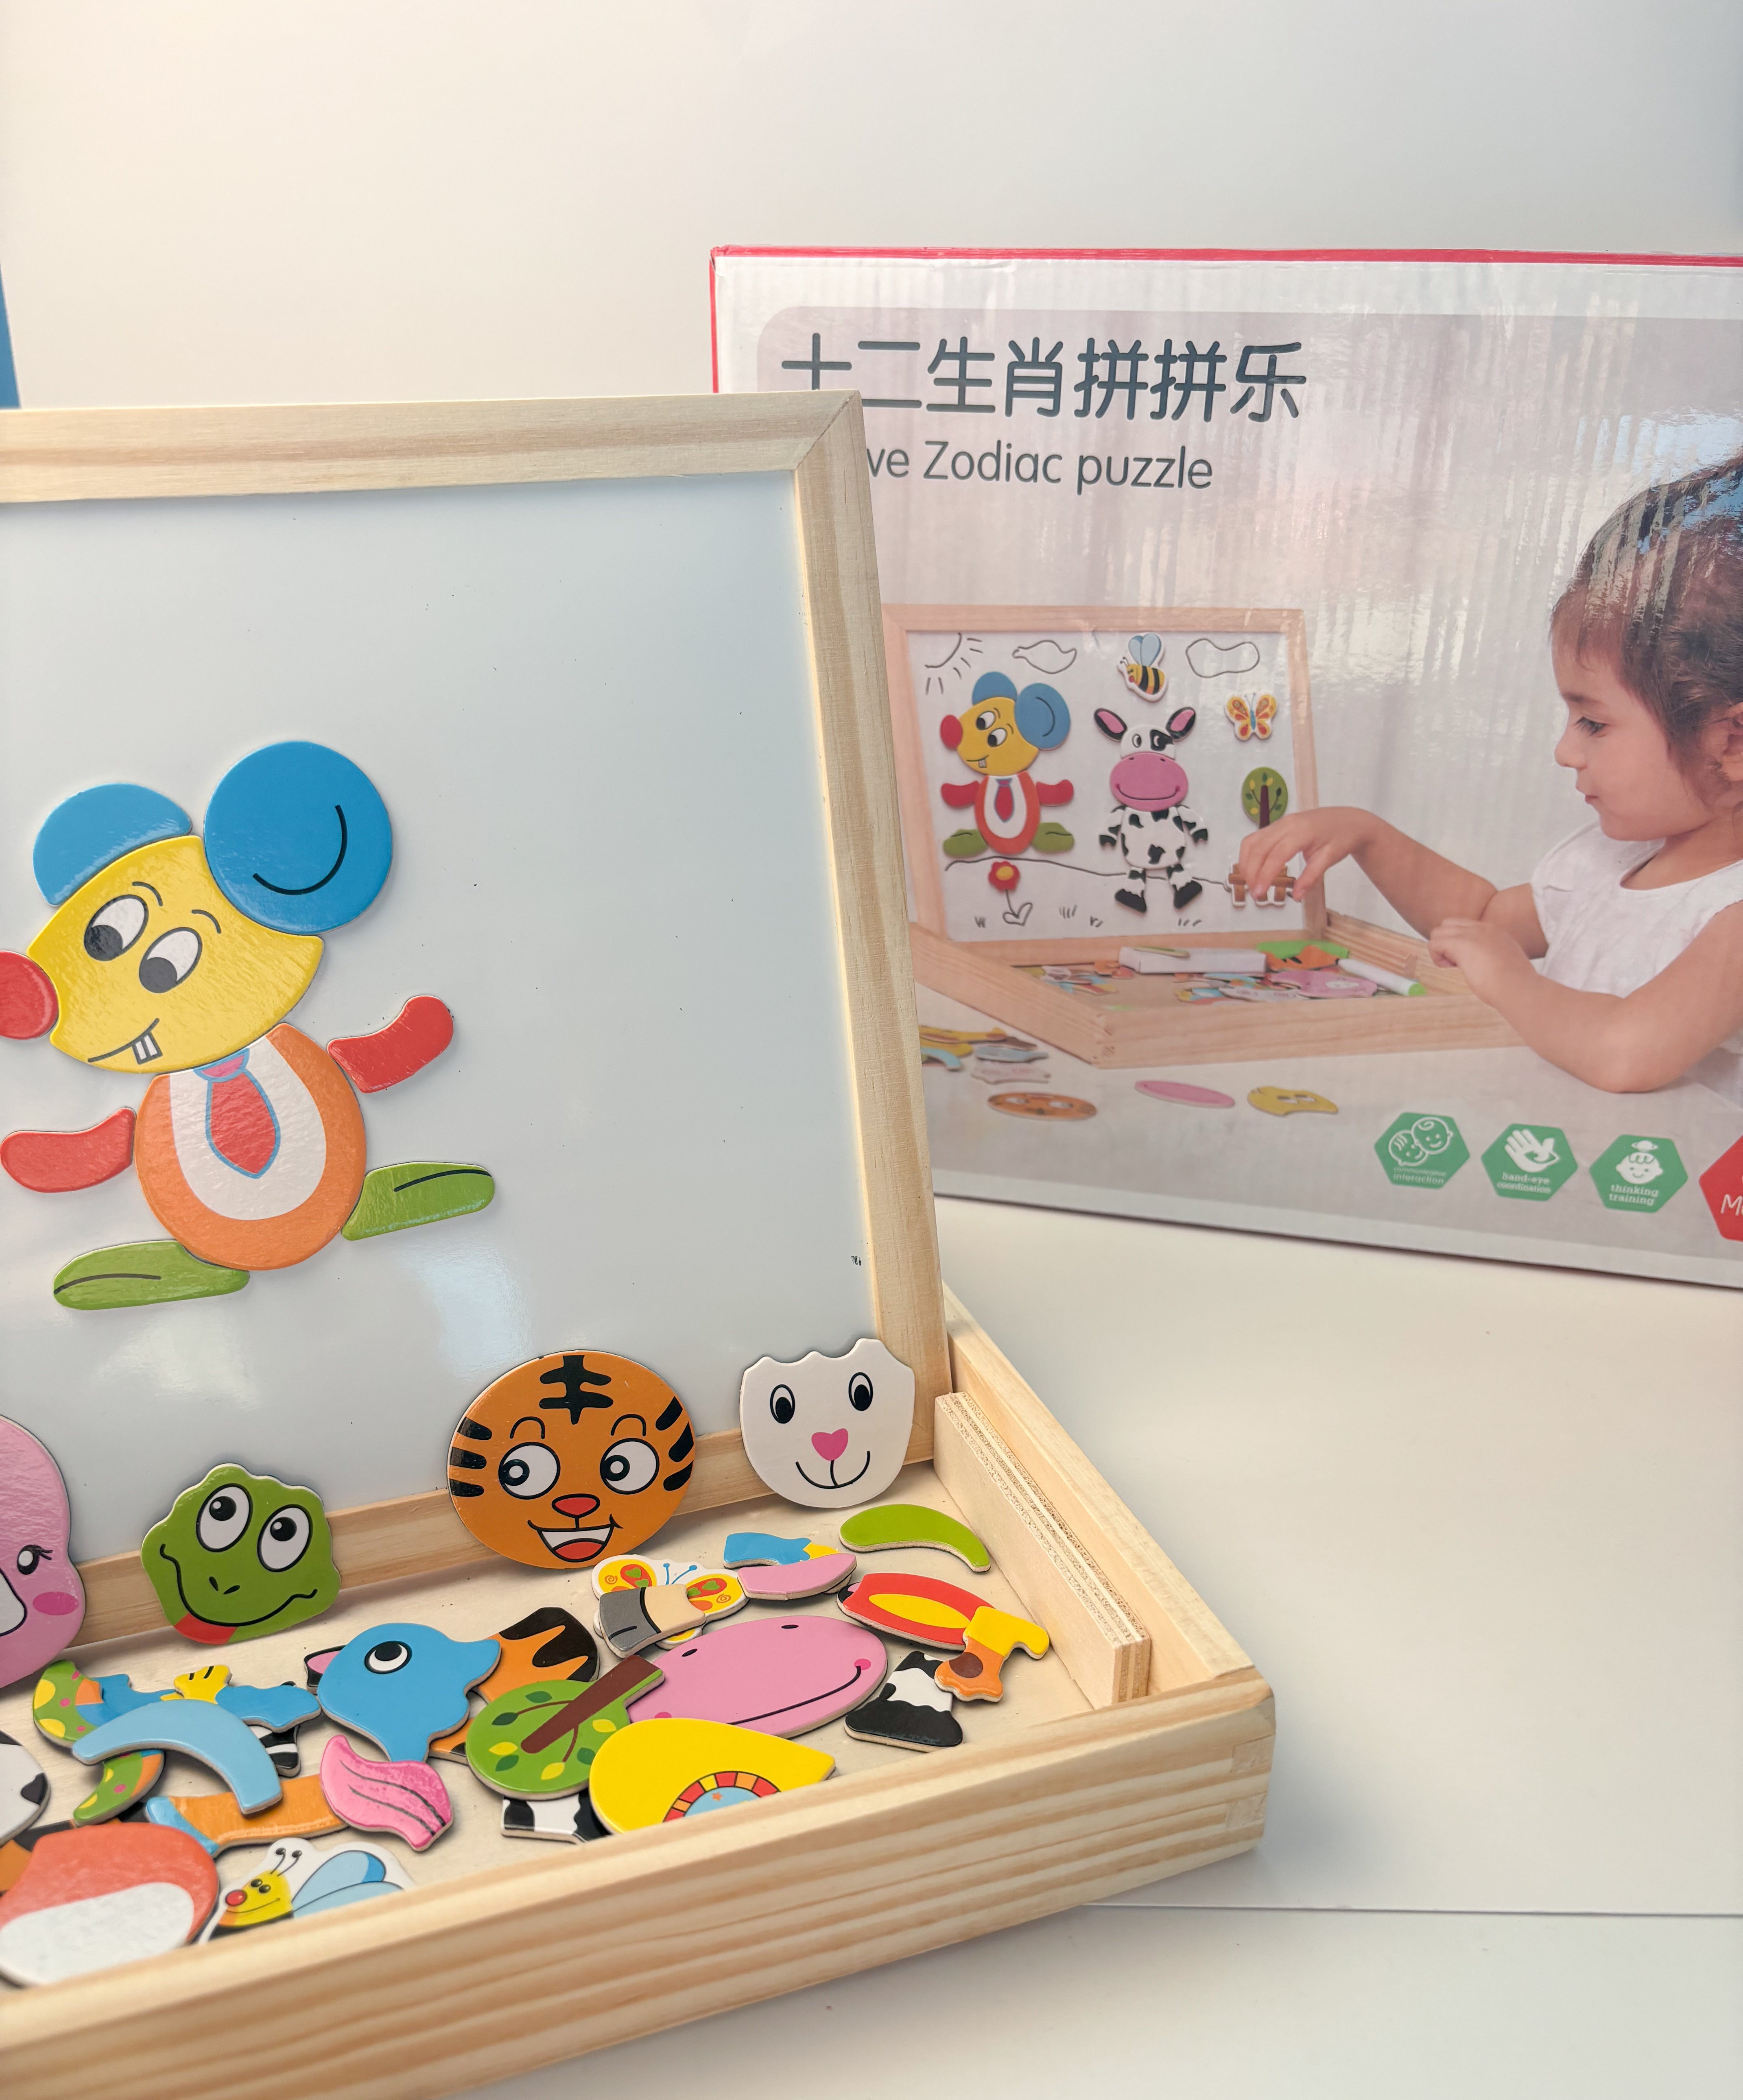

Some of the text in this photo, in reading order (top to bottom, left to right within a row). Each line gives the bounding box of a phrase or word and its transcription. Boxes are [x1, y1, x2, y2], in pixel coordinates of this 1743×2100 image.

[781, 332, 1307, 423] 十二生肖拼拼乐
[867, 440, 1213, 496] ve Zodiac puzzle
[1496, 1181, 1551, 1194] coordination
[1610, 1183, 1659, 1197] thinking
[1609, 1192, 1655, 1206] training
[1720, 1194, 1743, 1217] M
